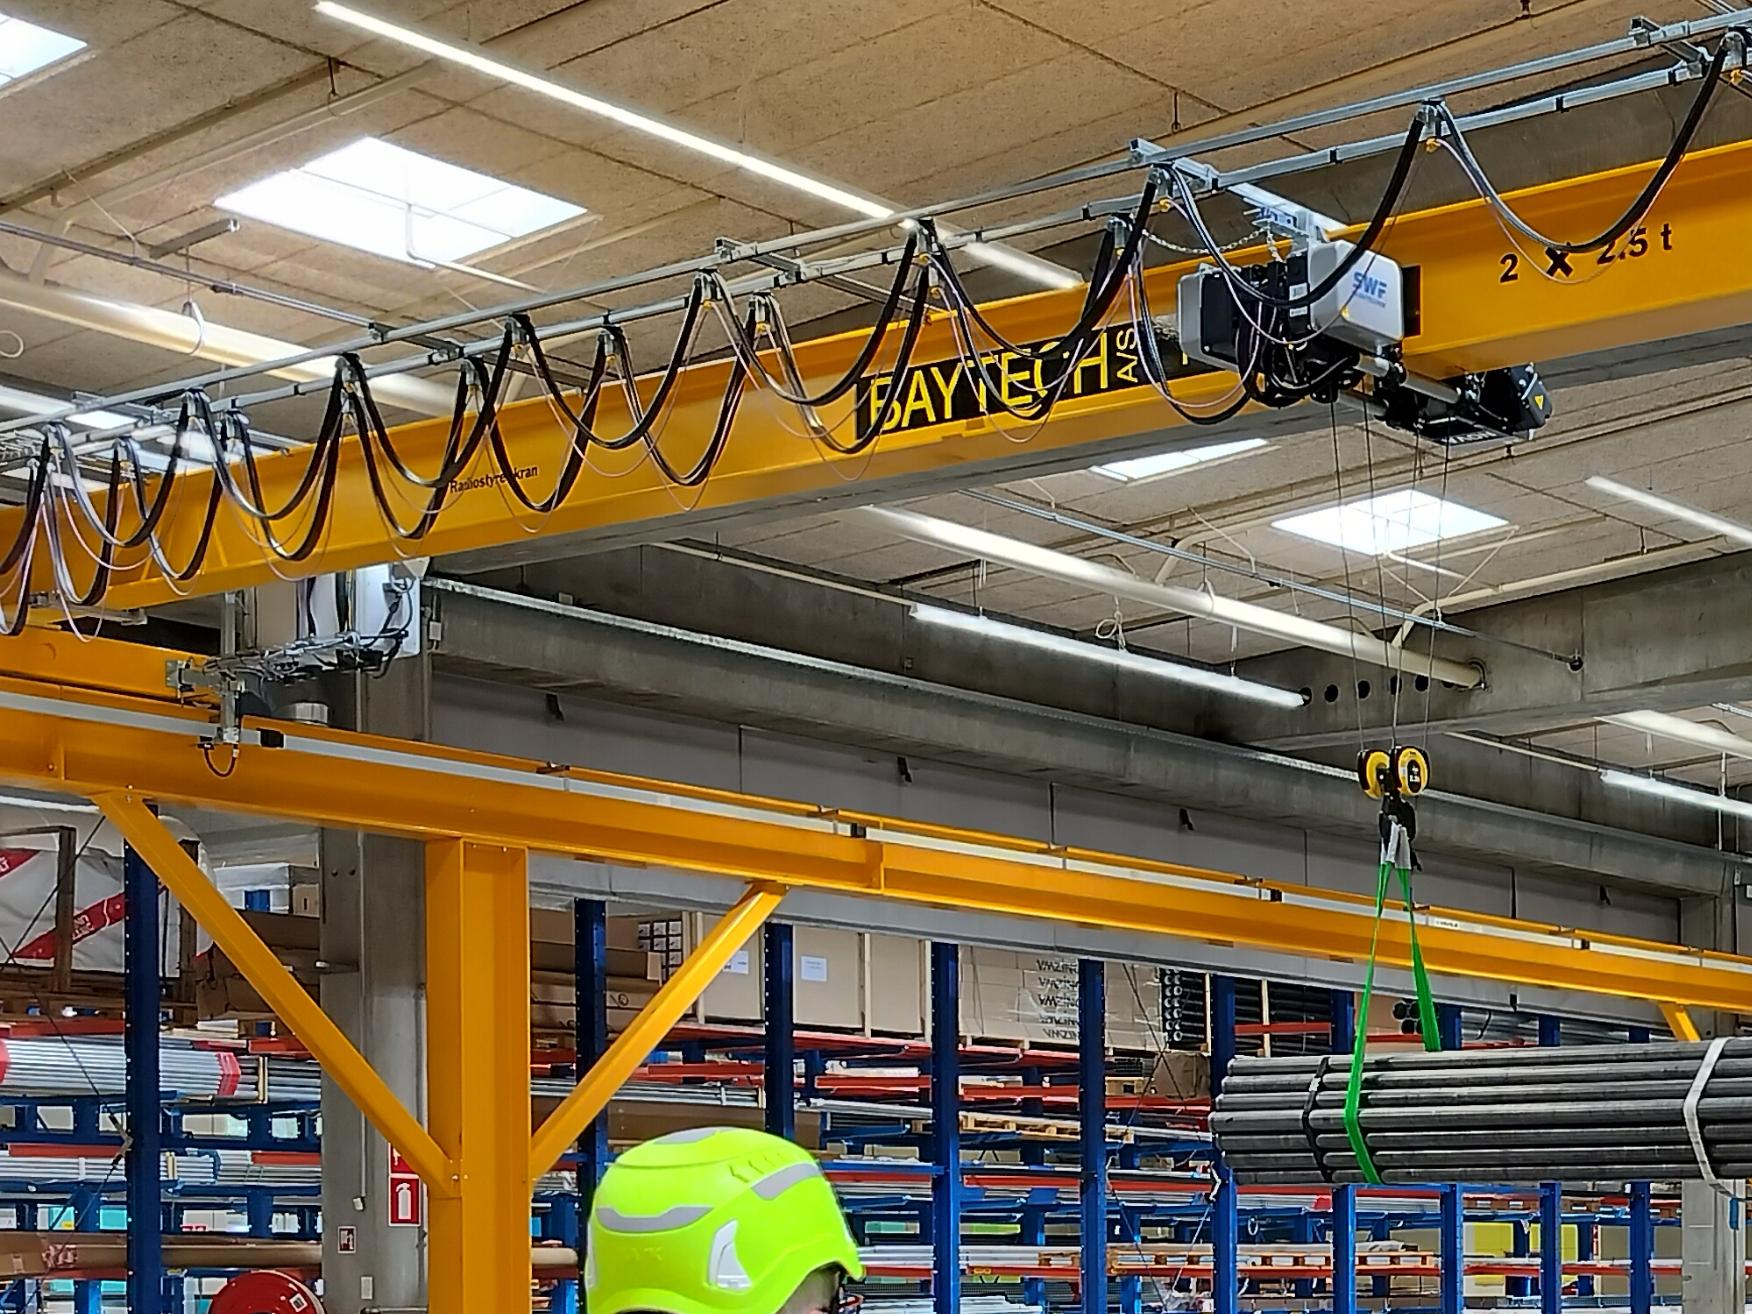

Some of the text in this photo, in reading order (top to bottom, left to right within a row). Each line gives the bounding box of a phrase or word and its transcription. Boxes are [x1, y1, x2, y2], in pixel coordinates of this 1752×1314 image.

[1499, 252, 1519, 284] 2
[1660, 223, 1673, 251] t
[1353, 271, 1388, 299] SWF
